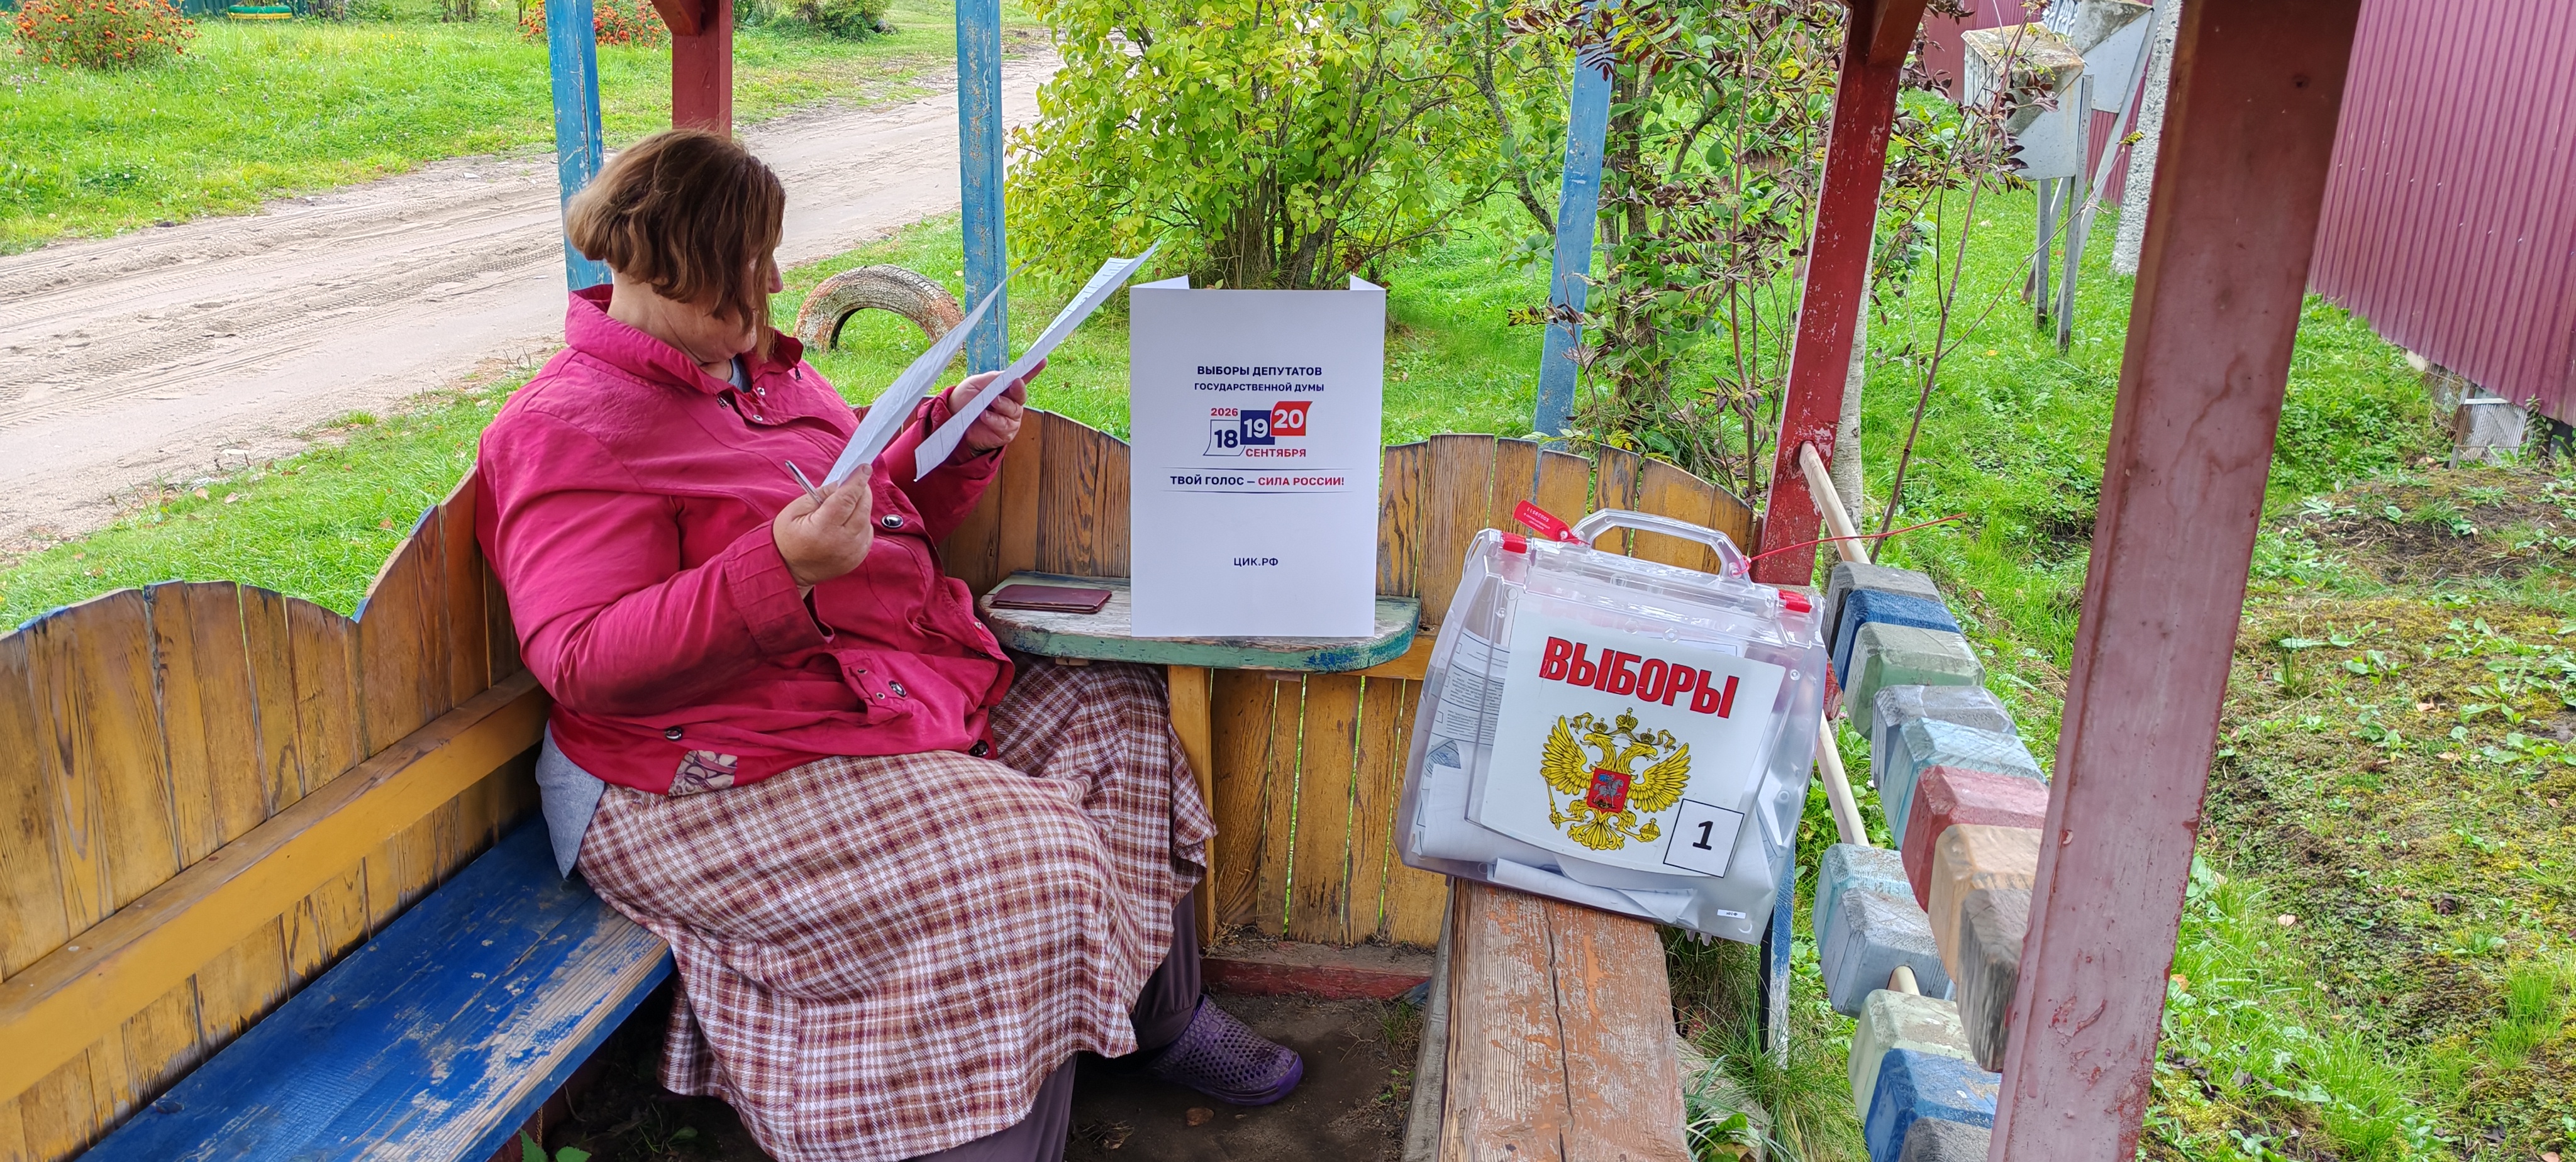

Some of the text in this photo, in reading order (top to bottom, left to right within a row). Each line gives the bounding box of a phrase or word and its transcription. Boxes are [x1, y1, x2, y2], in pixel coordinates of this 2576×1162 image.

[1197, 365, 1323, 377] ВЫБОРЫ ДЕПУТАТОВ
[1194, 382, 1324, 393] ГОСУДАРСТВЕННОЙ ДУМЫ
[1210, 407, 1238, 417] 2026
[1214, 409, 1304, 448] 18 19 20
[1245, 448, 1306, 458] СЕНТЯБРЯ
[1170, 473, 1202, 485] ТВОЙ
[1205, 476, 1244, 485] ГОЛОС
[1258, 477, 1290, 486] СИЛА
[1293, 477, 1344, 486] РОССИИ!
[1234, 557, 1279, 567] ЦИК.РФ
[1538, 636, 1740, 719] ВЫБОРЫ
[1692, 821, 1714, 851] 1
